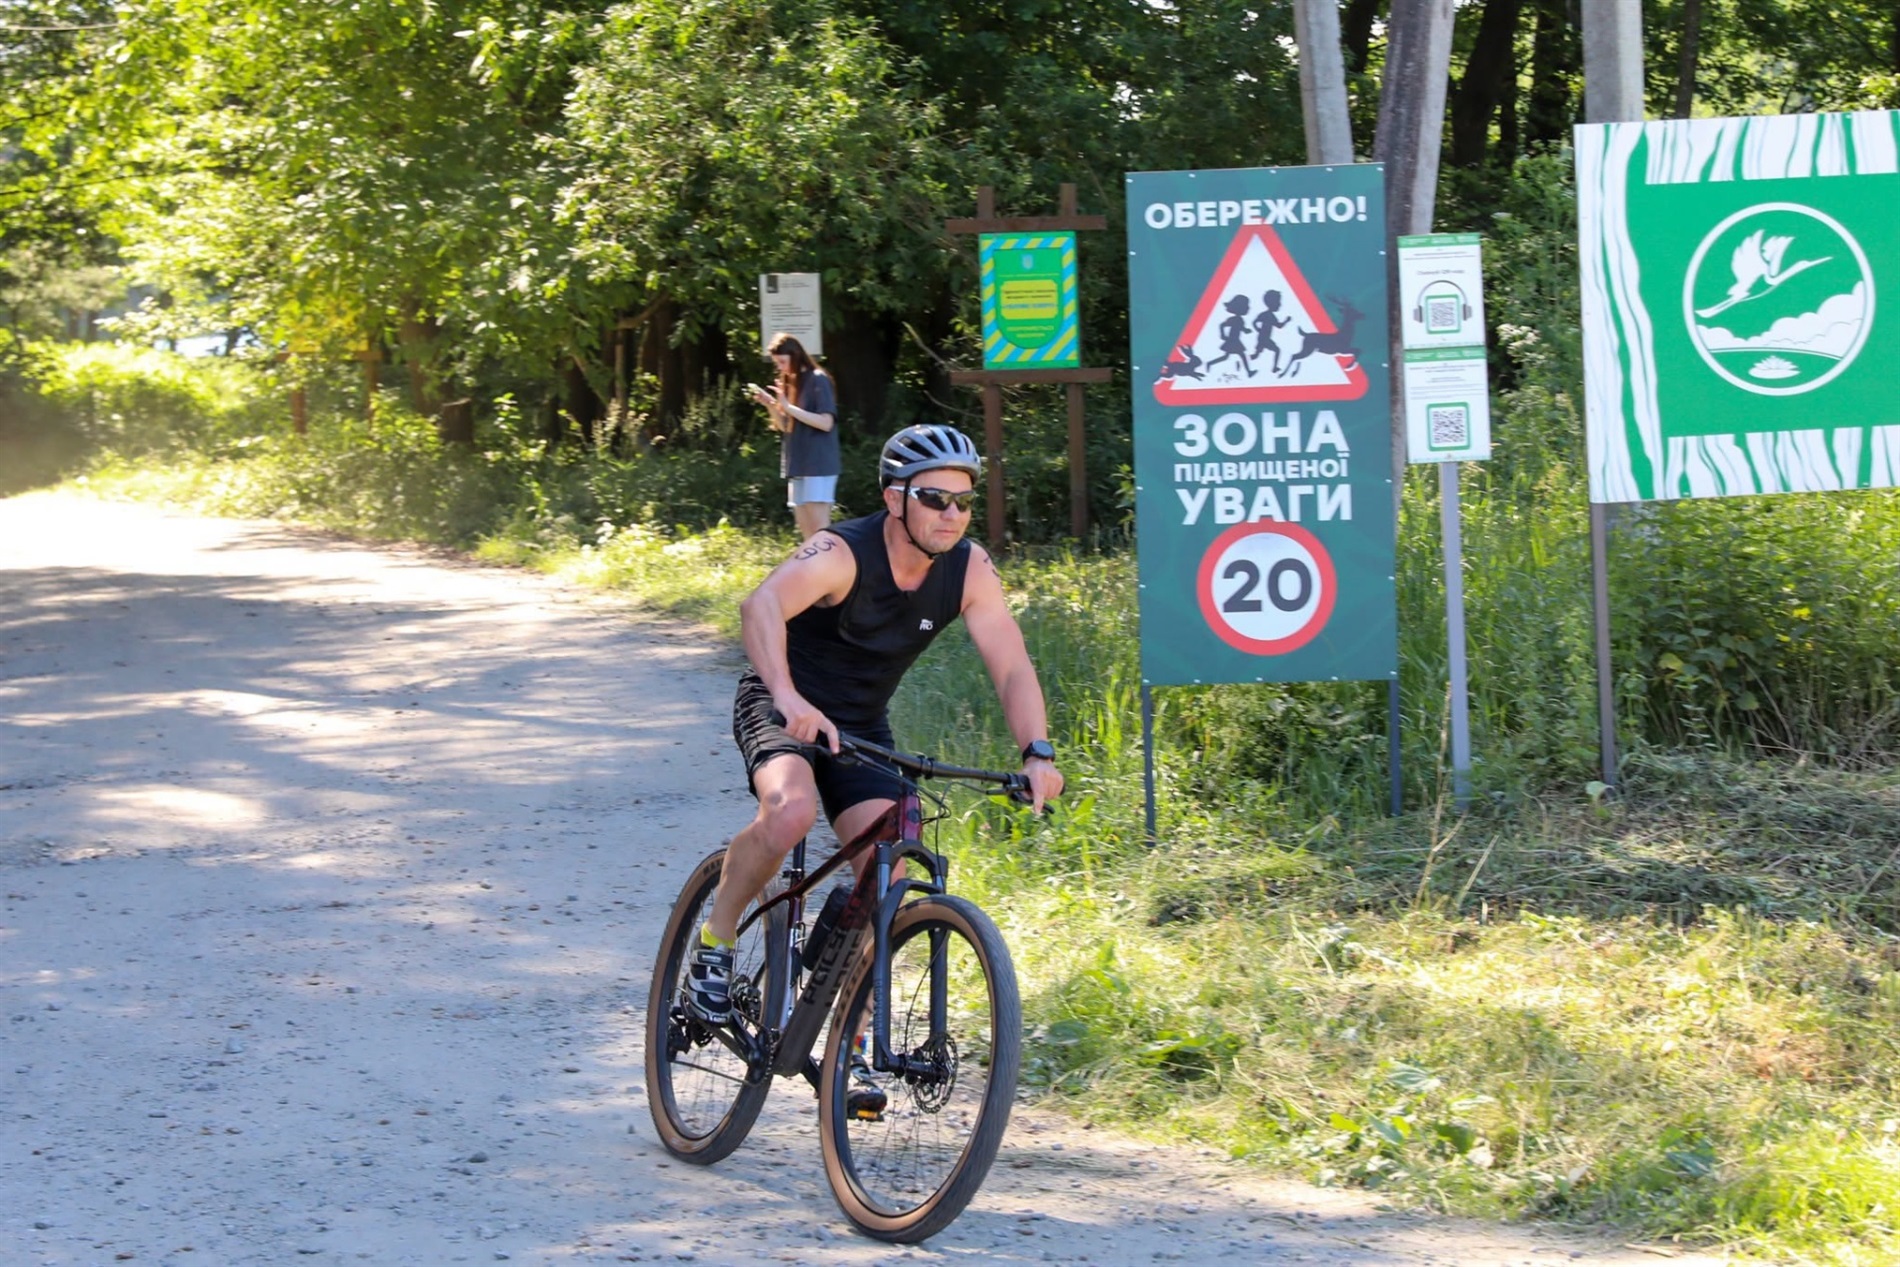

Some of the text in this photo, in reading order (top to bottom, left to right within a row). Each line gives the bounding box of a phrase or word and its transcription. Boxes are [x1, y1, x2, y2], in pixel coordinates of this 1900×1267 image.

[1144, 195, 1368, 230] ОБЕРЕЖНО!
[1173, 410, 1351, 457] ЗОНА
[1174, 453, 1350, 485] ПІДВИЩЕНОЇ
[1175, 483, 1352, 526] УВАГИ
[1222, 557, 1313, 613] 20
